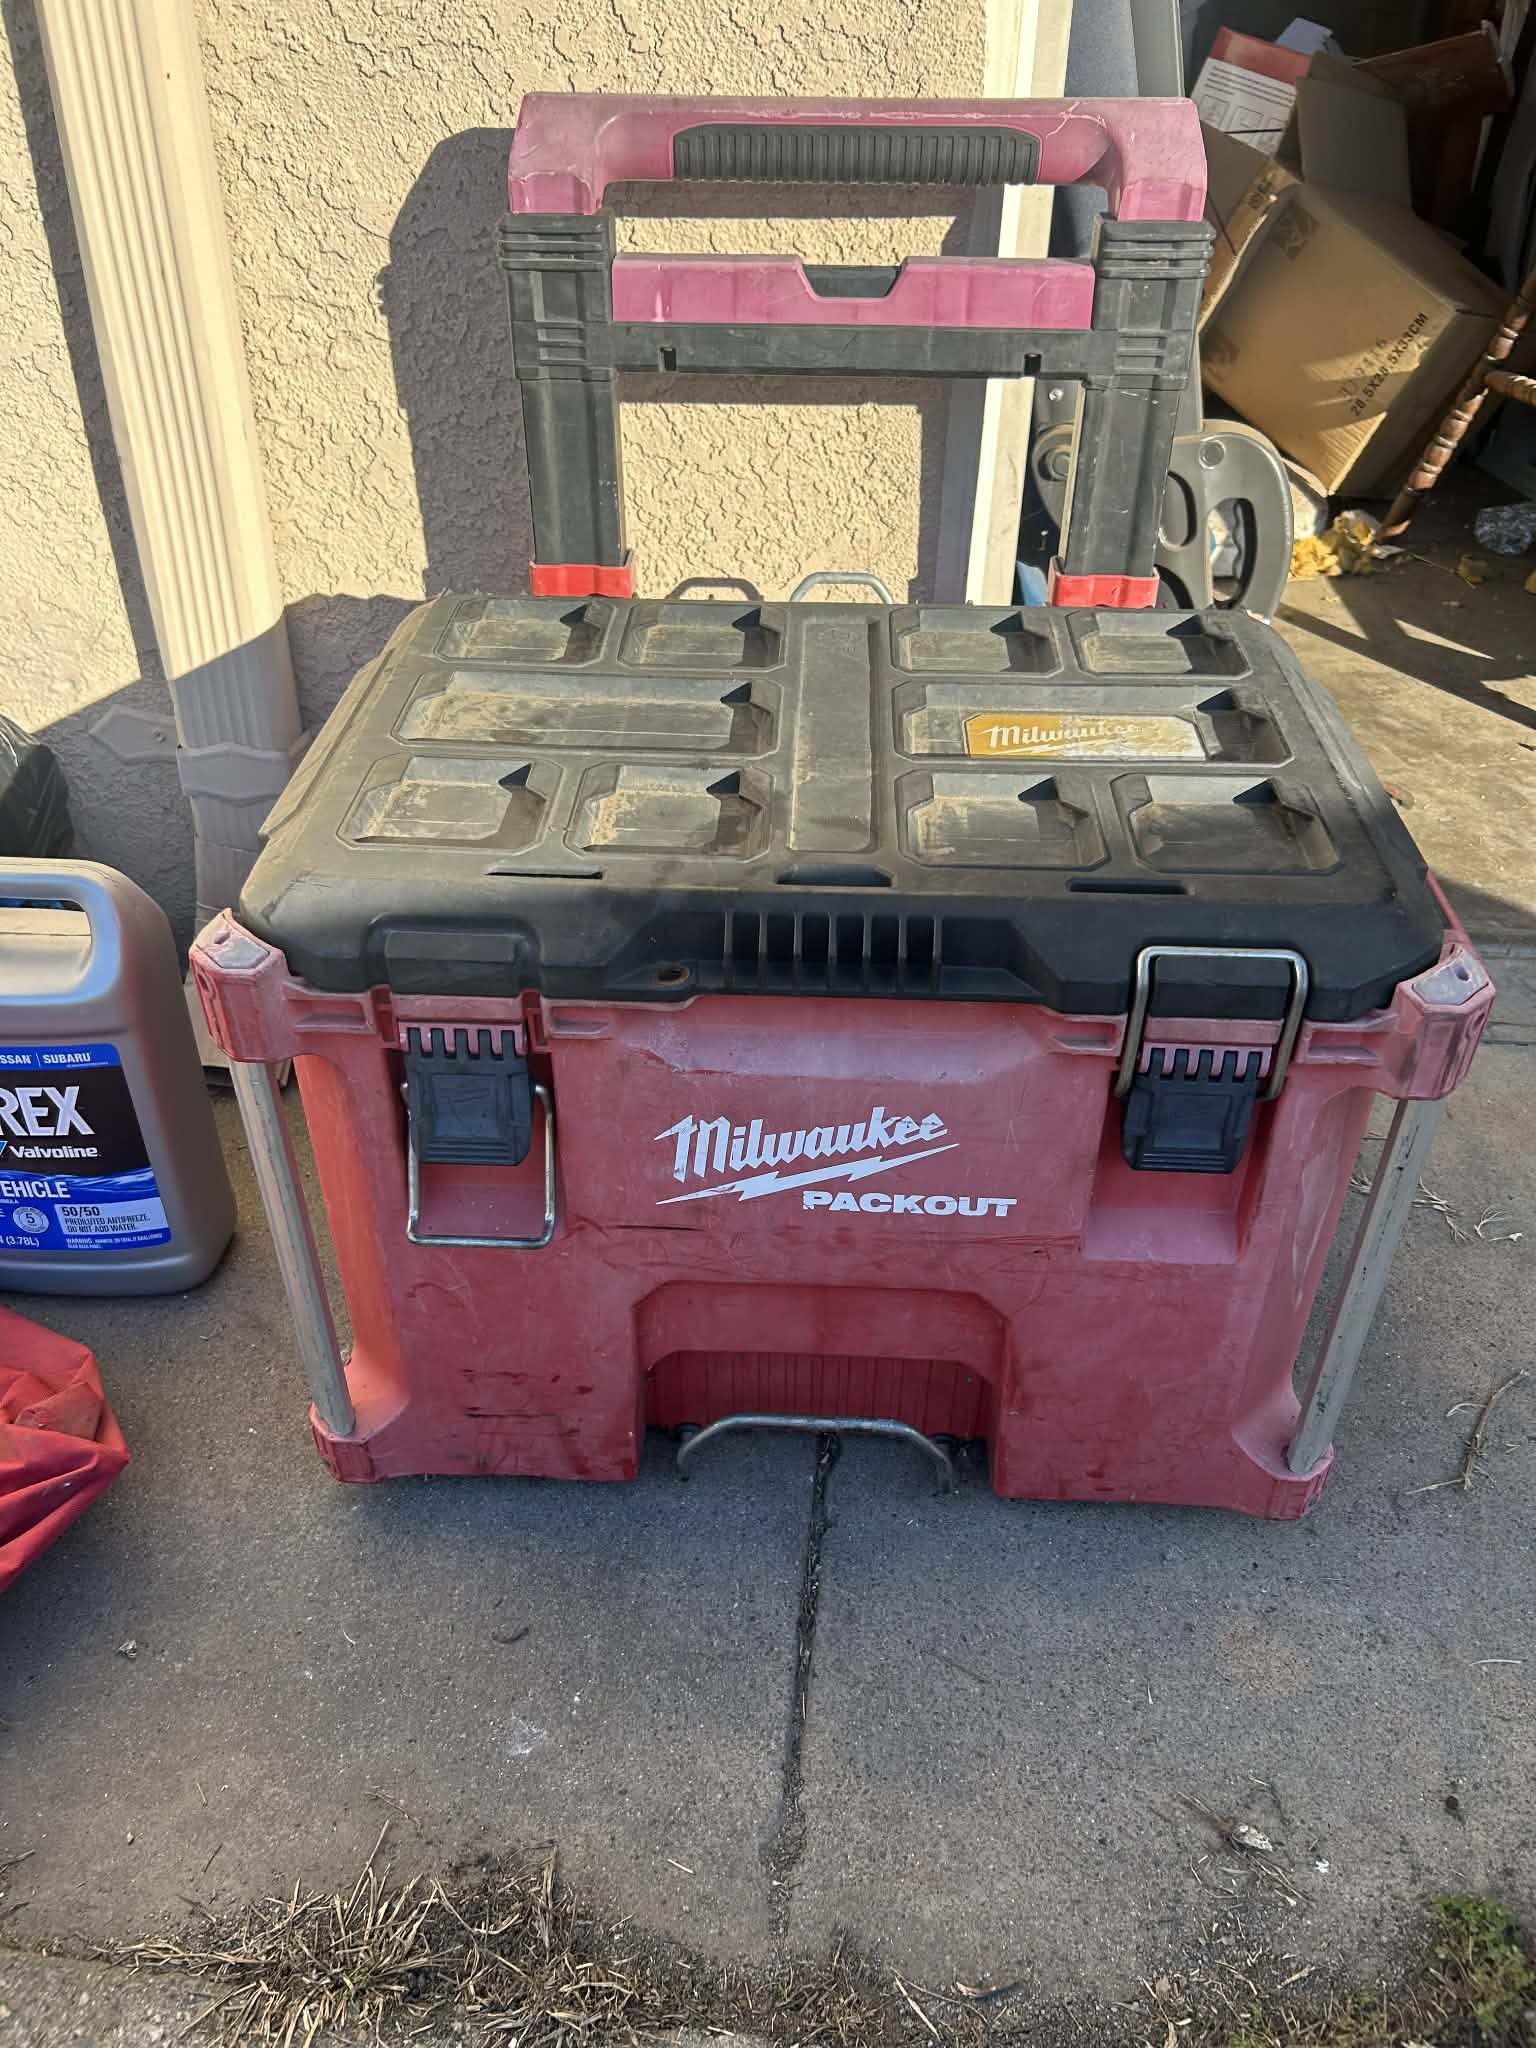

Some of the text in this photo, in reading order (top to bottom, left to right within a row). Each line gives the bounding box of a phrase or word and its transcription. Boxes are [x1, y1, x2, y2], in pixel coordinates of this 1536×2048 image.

[42, 1052, 91, 1064] SUBARU
[654, 1105, 949, 1183] Milwaukee
[9, 1145, 98, 1159] Valvoline
[802, 1190, 1017, 1217] PACKOUT
[62, 1206, 100, 1217] 50/50
[25, 1212, 36, 1224] 5
[65, 1216, 106, 1225] PREDILUTED
